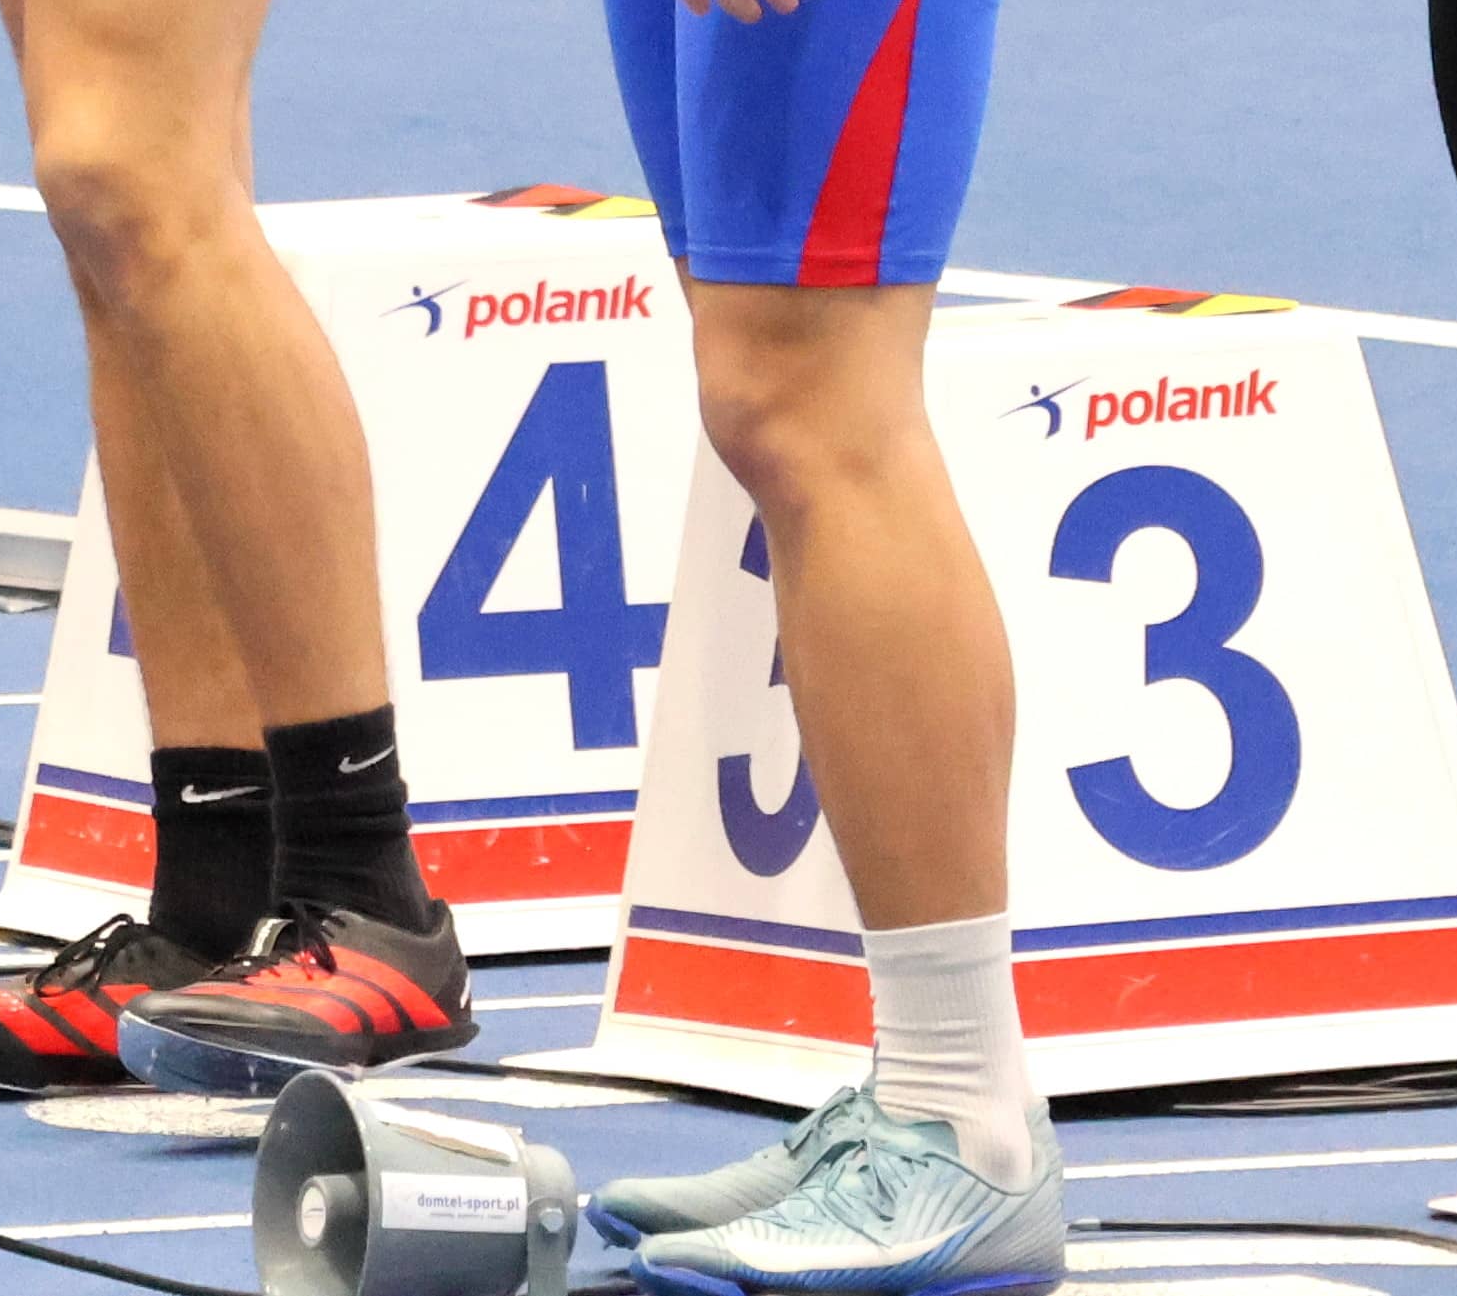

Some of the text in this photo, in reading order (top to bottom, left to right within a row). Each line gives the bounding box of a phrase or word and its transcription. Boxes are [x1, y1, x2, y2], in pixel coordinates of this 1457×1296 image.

[463, 274, 654, 340] polanik
[1085, 369, 1279, 441] polanik
[417, 360, 671, 751] 4
[1049, 464, 1302, 872] 3
[416, 1193, 520, 1212] domtel-sport.pl
